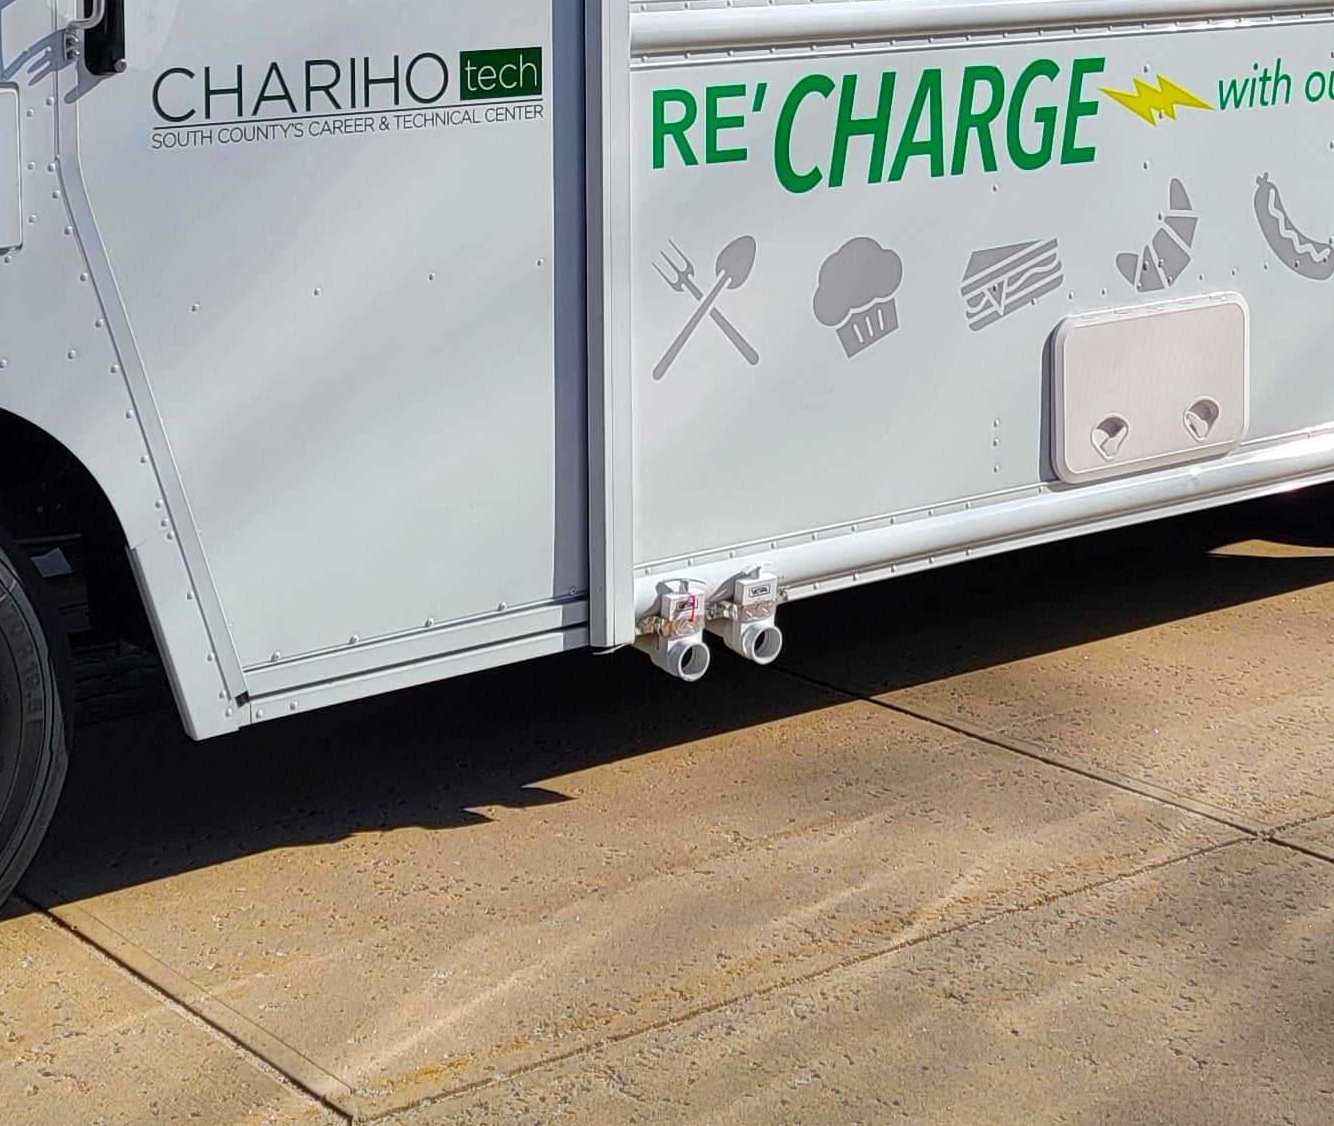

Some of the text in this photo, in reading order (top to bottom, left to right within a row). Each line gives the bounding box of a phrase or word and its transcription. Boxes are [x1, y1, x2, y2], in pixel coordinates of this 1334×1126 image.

[152, 52, 538, 123] CHARIHO tech
[1217, 58, 1293, 110] with
[151, 104, 544, 150] SOUTH COUNTY'S CAREER & TECHNICAL CENTER
